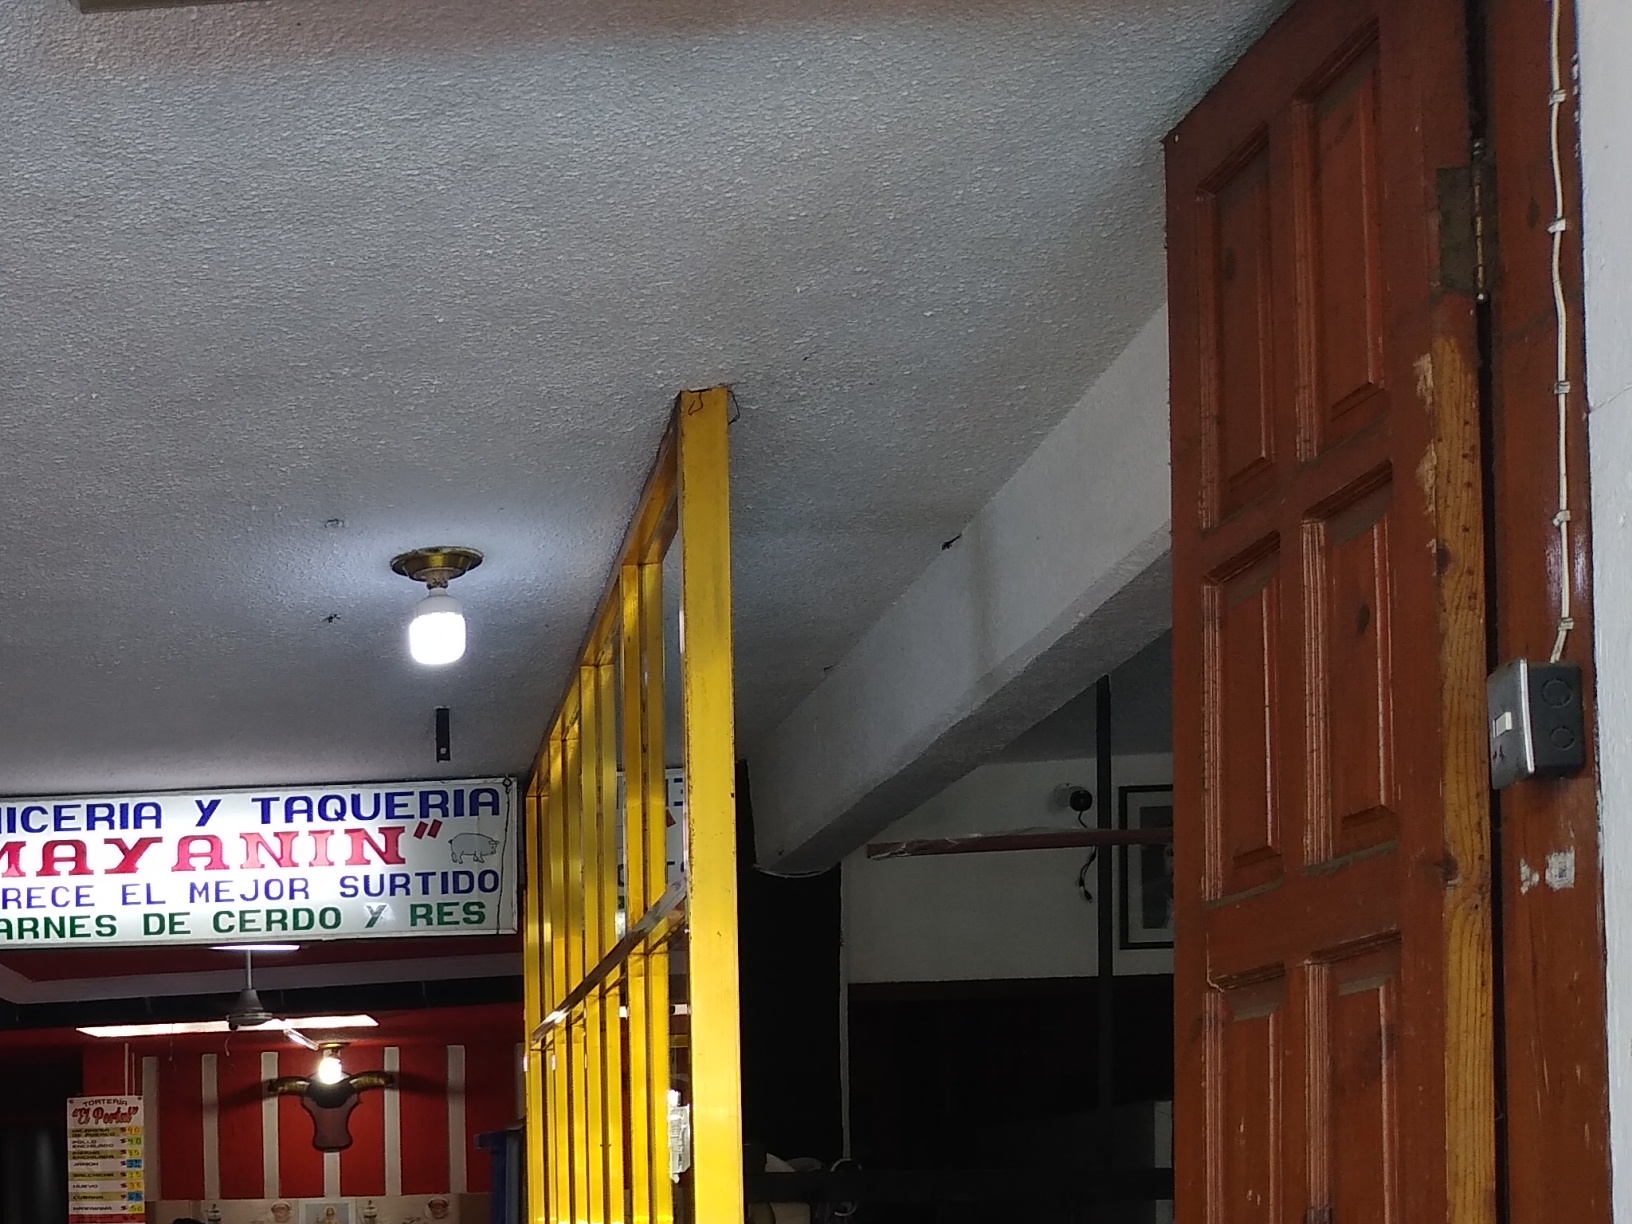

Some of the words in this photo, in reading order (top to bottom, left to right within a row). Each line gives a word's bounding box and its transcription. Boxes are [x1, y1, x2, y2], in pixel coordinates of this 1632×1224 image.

[194, 798, 223, 825] Y
[251, 787, 500, 823] TAQUERIA
[120, 883, 168, 906] EL
[189, 877, 310, 905] MEJOR
[338, 869, 500, 899] SURTIDO
[143, 911, 192, 936] DE
[212, 906, 342, 935] CERDO
[363, 904, 390, 928] Y
[410, 902, 487, 927] RES
